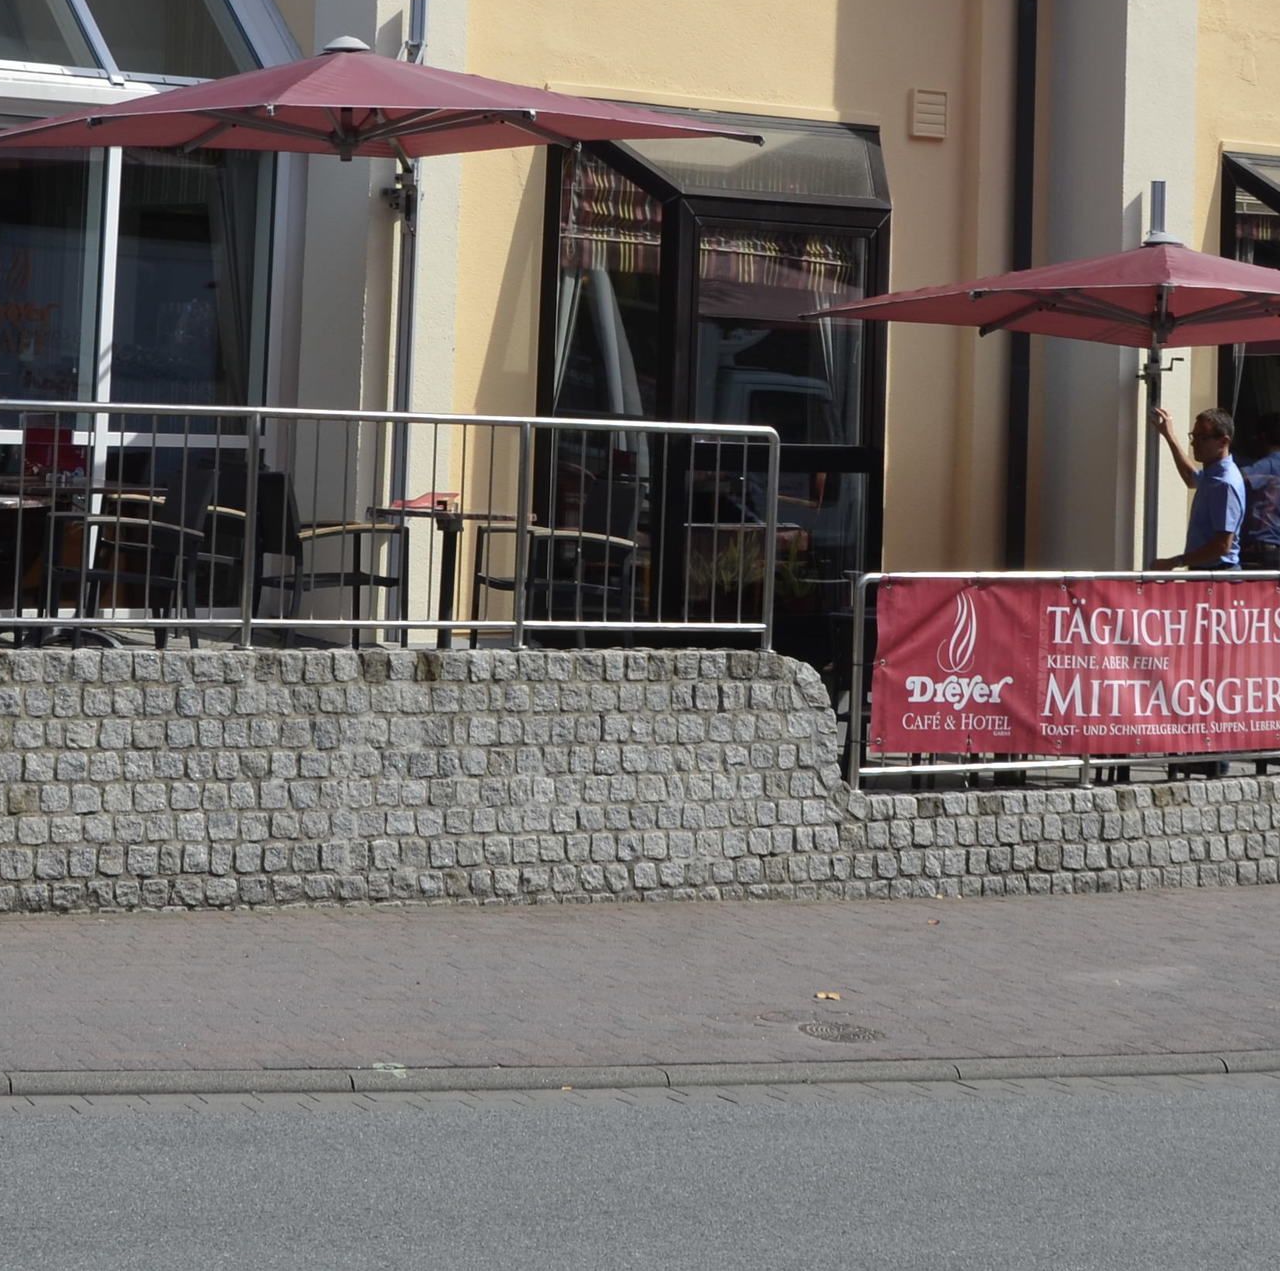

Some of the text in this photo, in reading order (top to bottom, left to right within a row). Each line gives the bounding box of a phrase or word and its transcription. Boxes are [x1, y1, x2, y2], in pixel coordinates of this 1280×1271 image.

[1046, 598, 1188, 646] TÄGLICH
[1047, 655, 1170, 671] KLEINE, ABER FEINE
[905, 675, 1013, 710] Dreyer
[902, 712, 1011, 731] CAFÉ & HOTEL
[1040, 722, 1080, 736] TOAST-
[1083, 724, 1107, 735] UND
